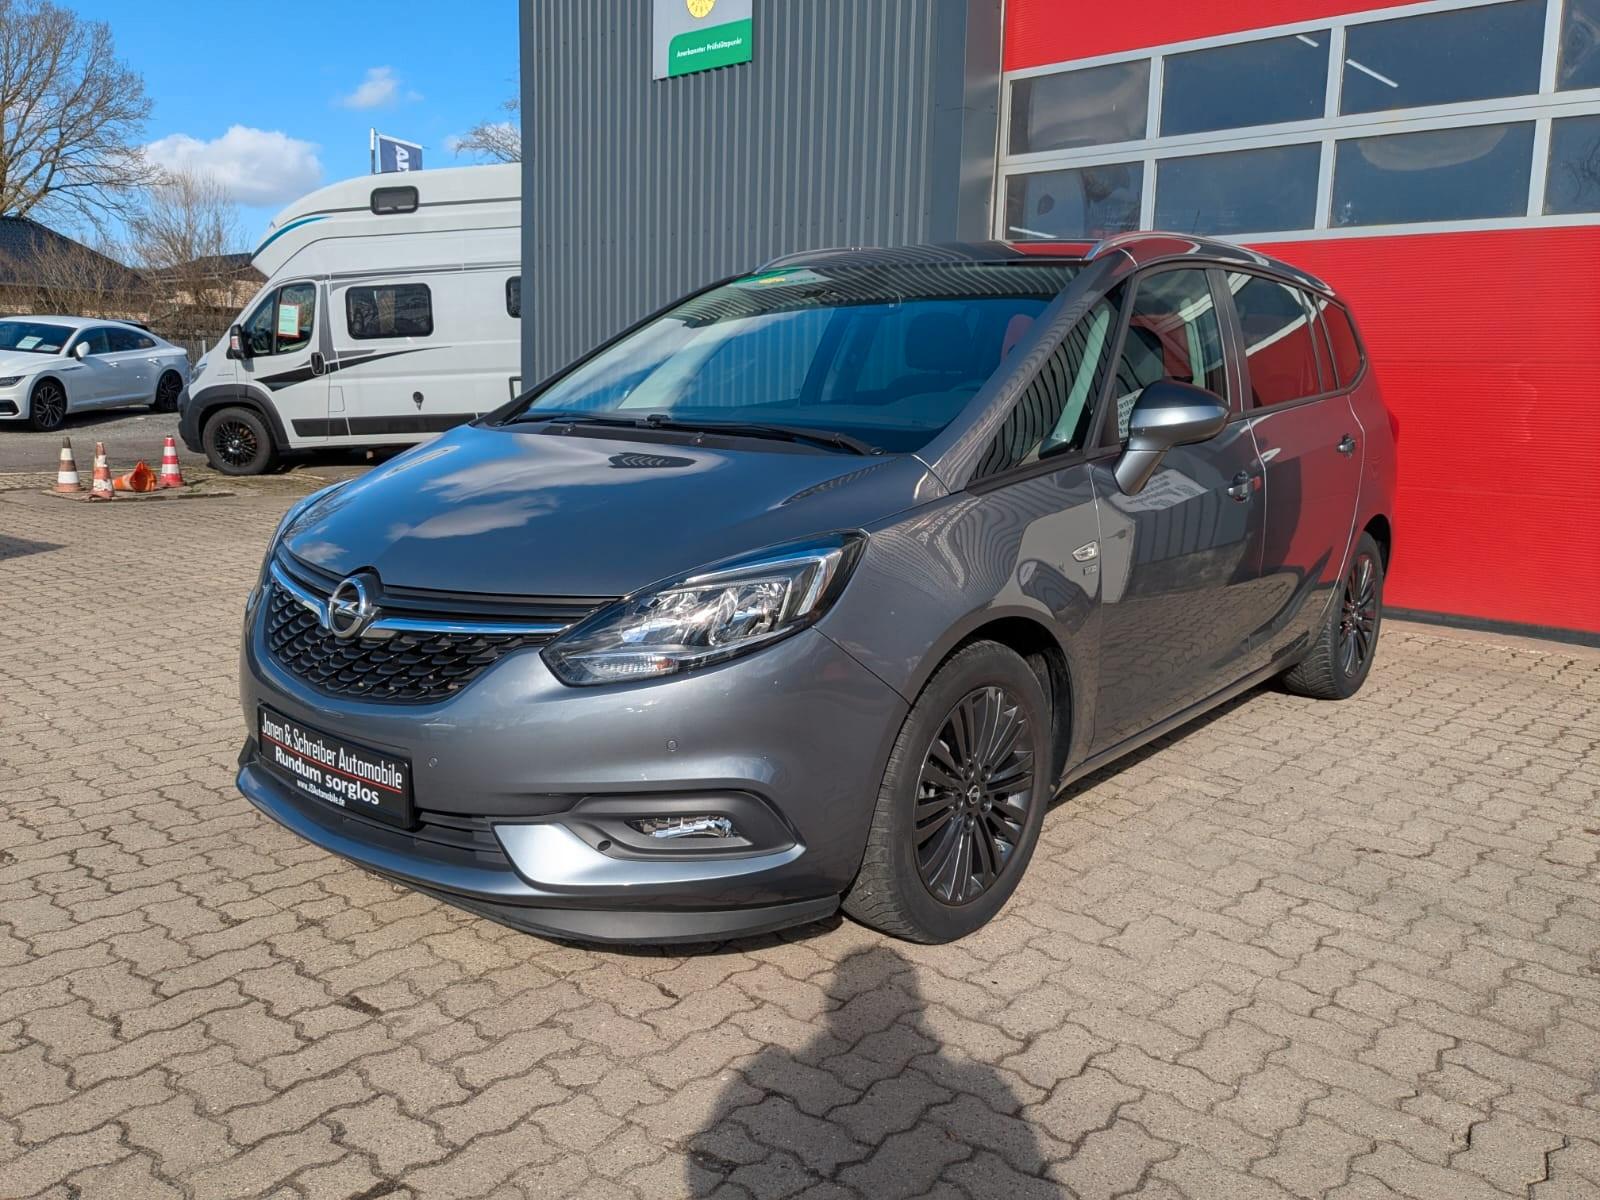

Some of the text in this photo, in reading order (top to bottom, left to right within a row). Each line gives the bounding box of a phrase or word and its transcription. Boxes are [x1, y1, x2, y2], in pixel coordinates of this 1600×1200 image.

[262, 712, 402, 789] Jonen & Schreiber Automobile
[275, 746, 380, 805] Rundum sorglos
[297, 779, 345, 807] www.JSAutomobile.de
